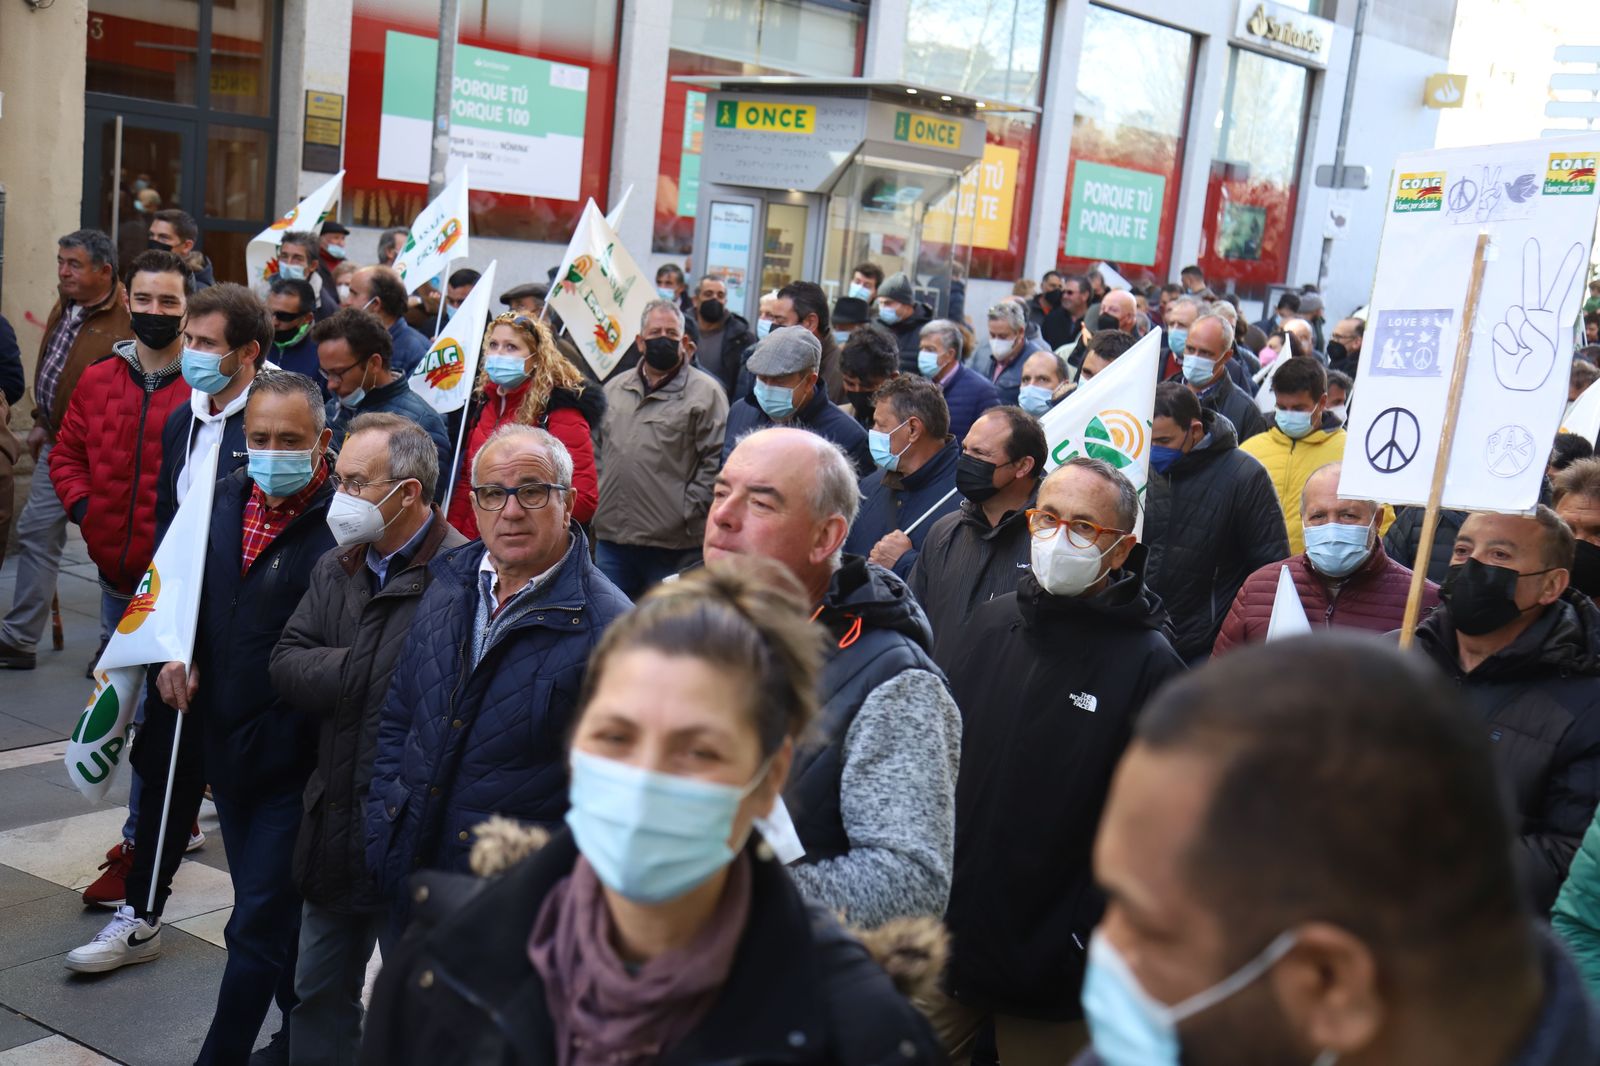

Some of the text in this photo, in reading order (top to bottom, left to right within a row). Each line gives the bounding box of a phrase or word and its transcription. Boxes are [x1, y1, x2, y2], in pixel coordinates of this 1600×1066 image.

[90, 17, 103, 40] 3
[453, 76, 528, 105] PORQUE TÚ
[507, 108, 530, 127] 100
[745, 106, 808, 129] ONCE
[914, 120, 957, 145] ONCE
[984, 160, 1004, 190] TÚ
[1550, 159, 1596, 170] COAG
[1400, 177, 1441, 189] COAG
[981, 195, 999, 221] TE
[1083, 180, 1154, 213] PORQUE TÚ
[1080, 209, 1149, 241] PORQUE TE
[1388, 317, 1417, 327] LOVE
[1487, 430, 1533, 456] PAZ
